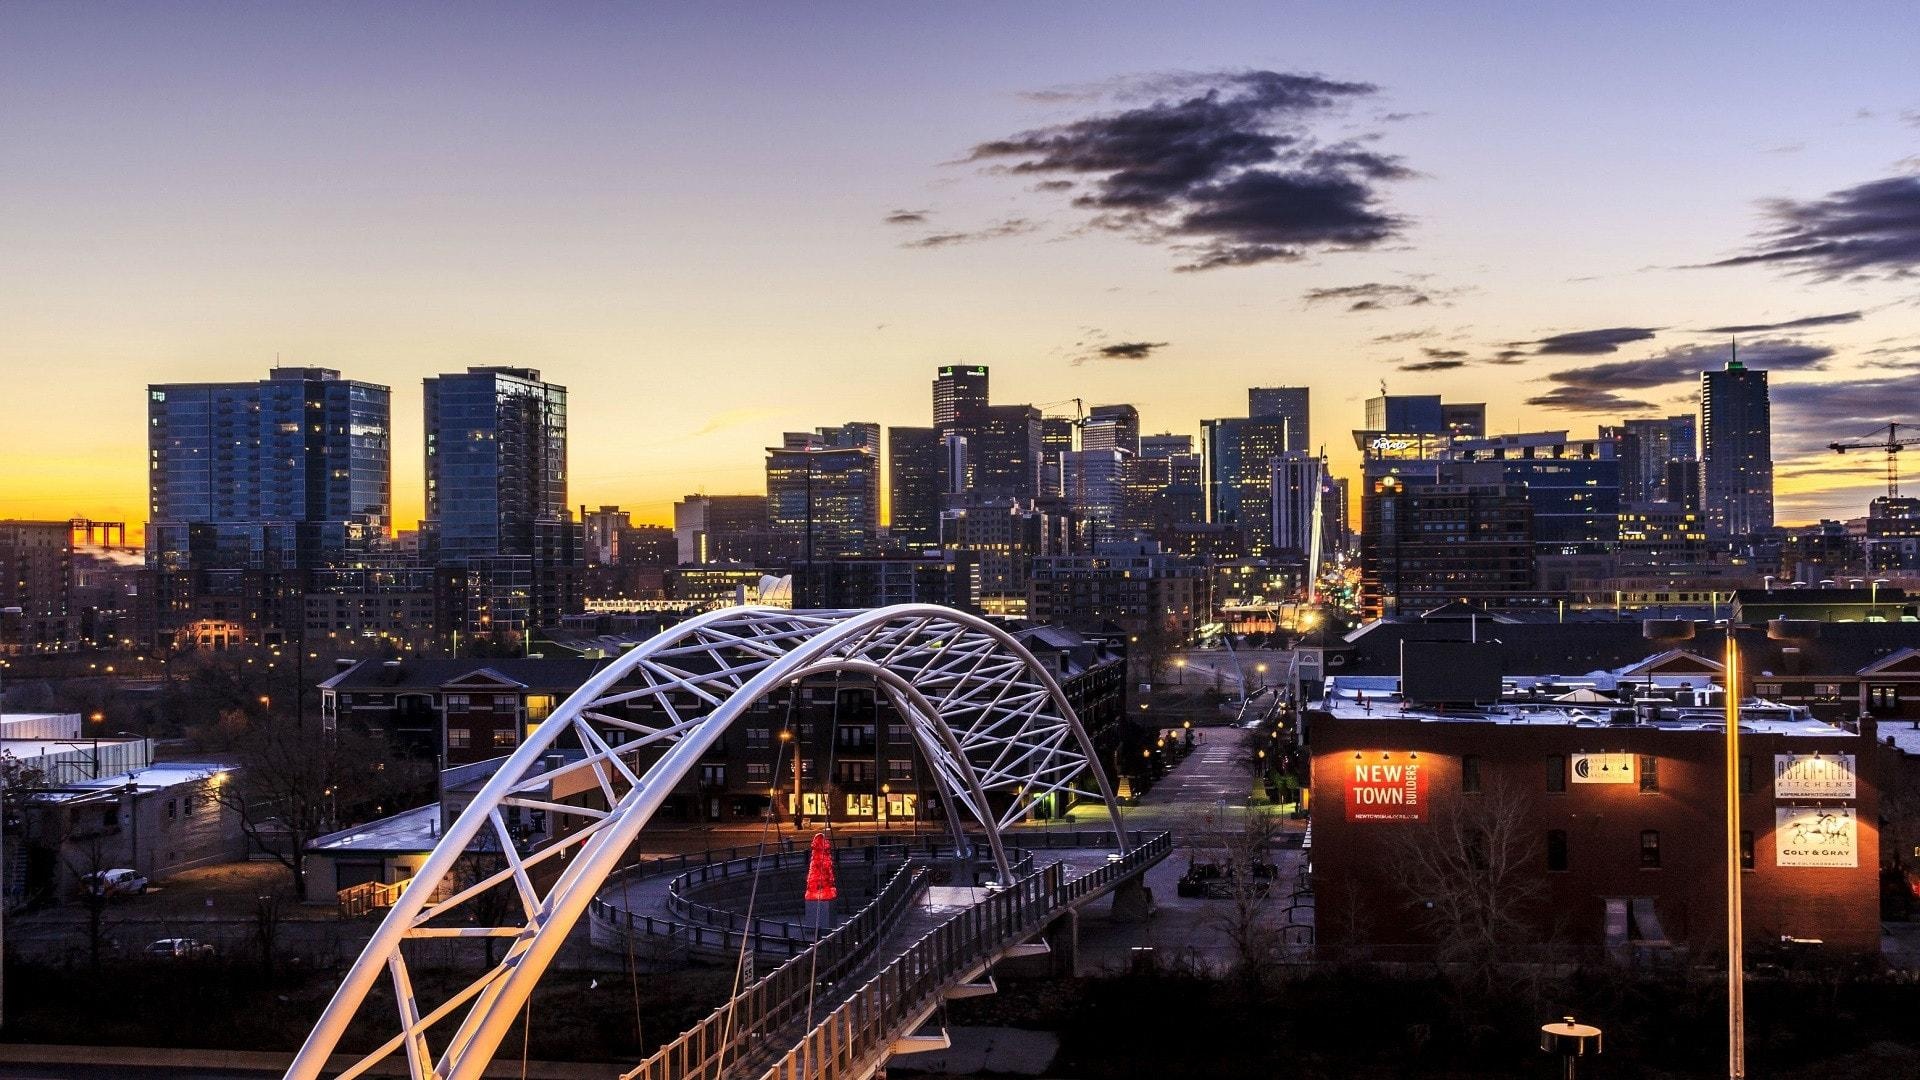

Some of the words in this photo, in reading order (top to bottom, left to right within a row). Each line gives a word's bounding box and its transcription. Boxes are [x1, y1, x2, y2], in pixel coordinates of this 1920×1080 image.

[1355, 765, 1402, 782] NEW
[1779, 761, 1816, 780] ASPEN
[1405, 764, 1417, 805] BUILDERS
[1353, 787, 1403, 805] TOWN
